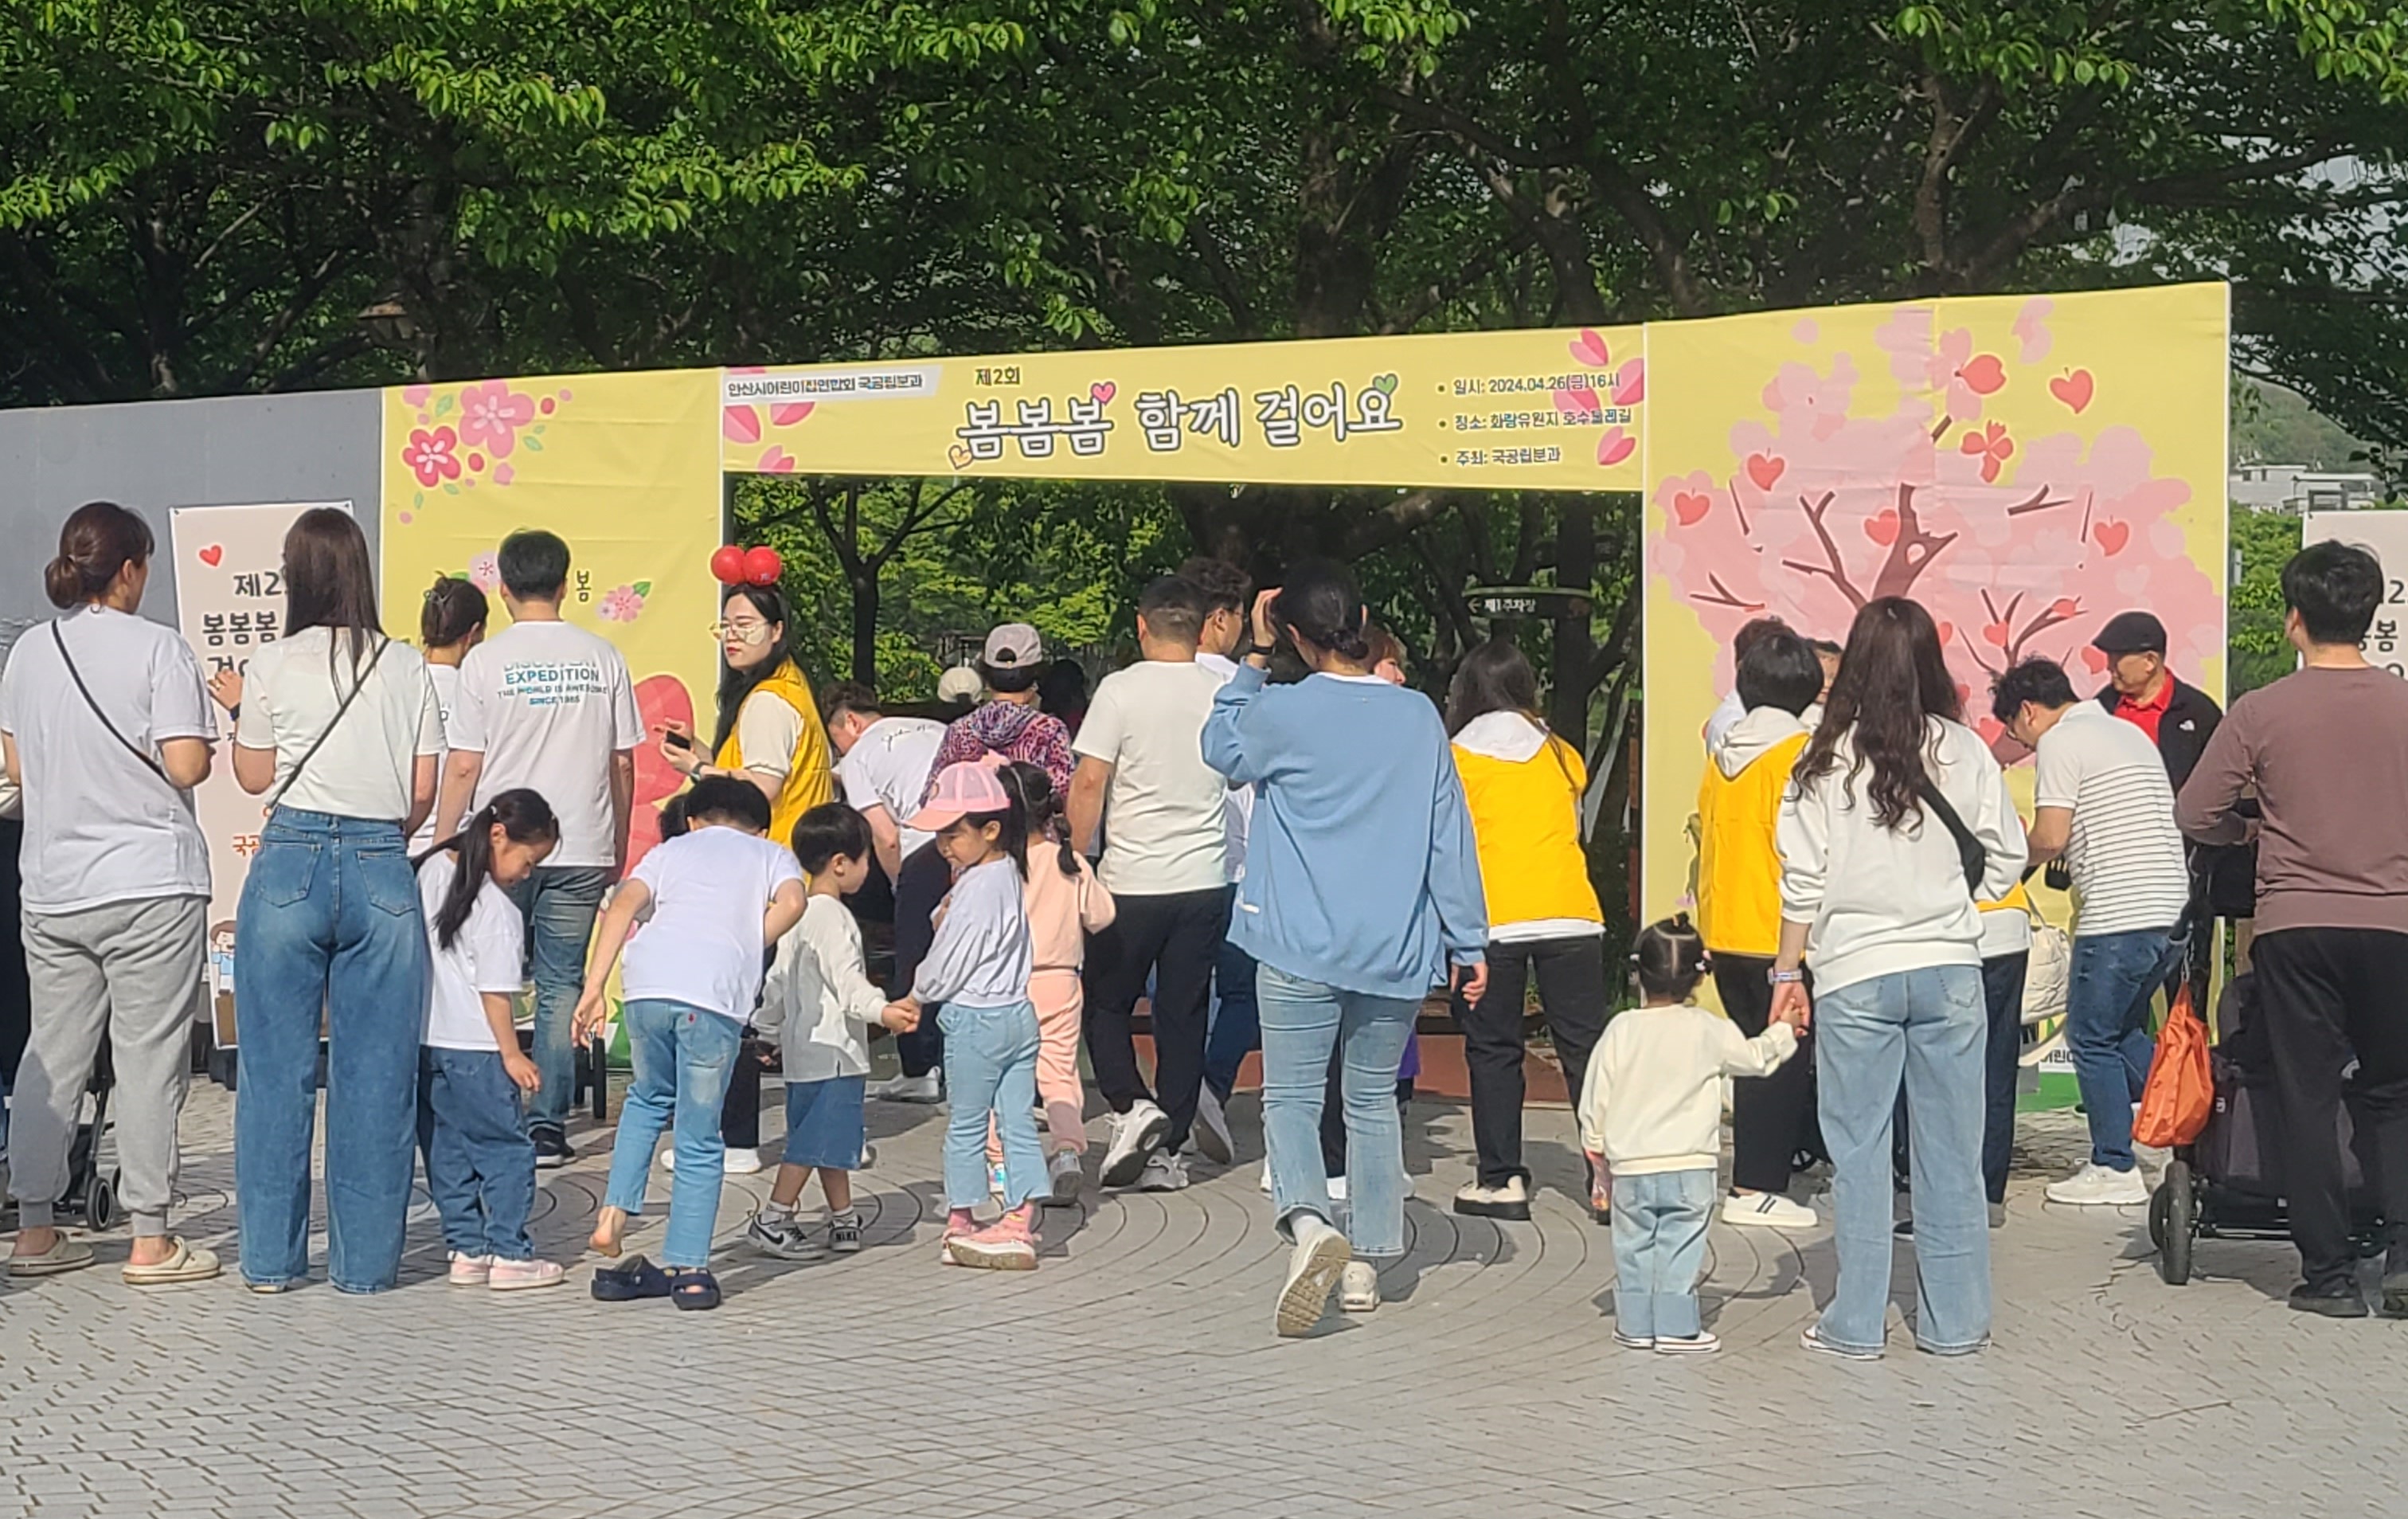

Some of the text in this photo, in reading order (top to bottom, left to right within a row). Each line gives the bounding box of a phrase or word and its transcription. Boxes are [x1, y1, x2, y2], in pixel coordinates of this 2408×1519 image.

[975, 366, 1020, 386] 제2회
[1453, 378, 1485, 395] 일시:
[956, 382, 1401, 460] 봄봄봄 함께 걸어요
[1490, 412, 1558, 429] 화랑유원지
[1456, 448, 1560, 465] 주최: 국공립분과
[202, 611, 279, 646] 봄봄봄
[505, 668, 599, 685] EXPEDITION
